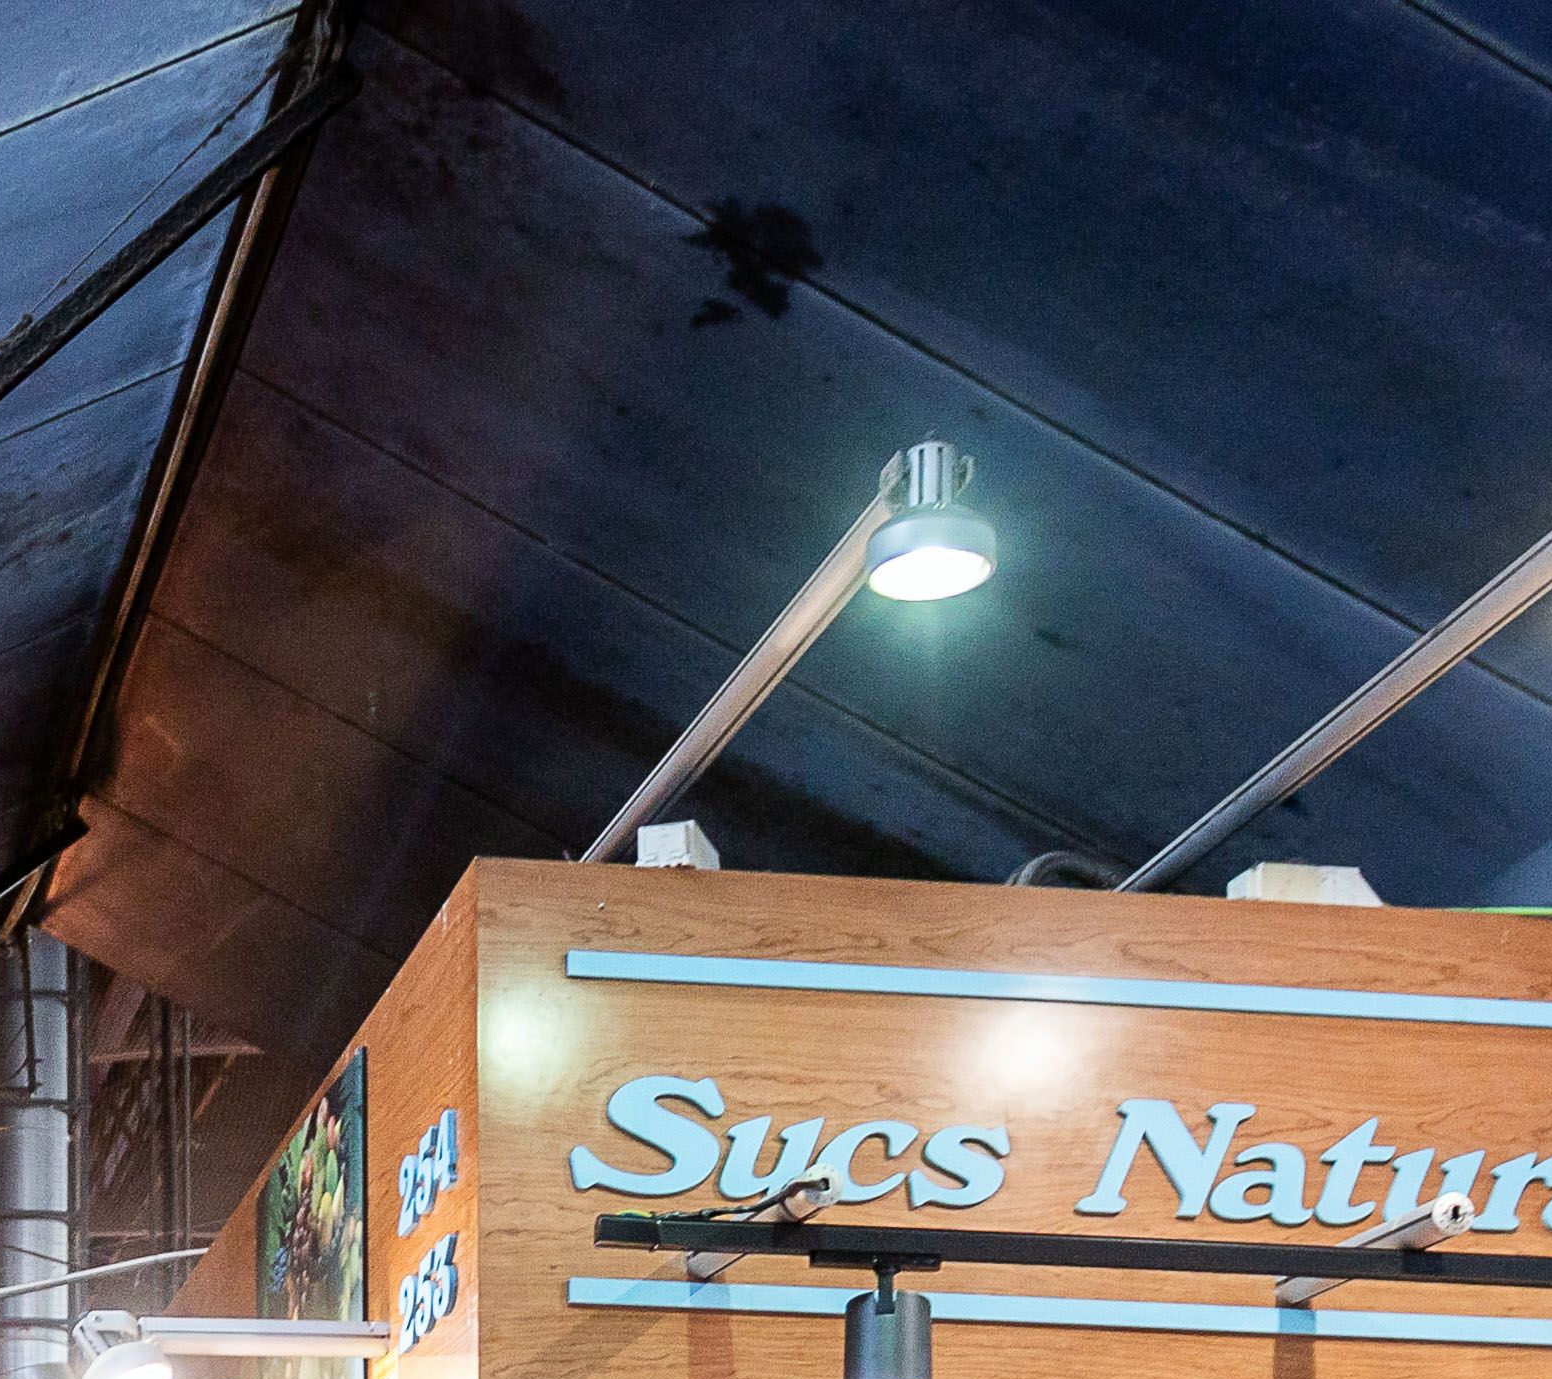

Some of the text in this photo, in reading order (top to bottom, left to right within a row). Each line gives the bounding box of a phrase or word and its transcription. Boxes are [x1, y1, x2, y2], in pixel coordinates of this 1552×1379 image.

[397, 1108, 460, 1236] 254
[568, 1074, 1013, 1210] Sucs
[397, 1232, 459, 1354] 253
